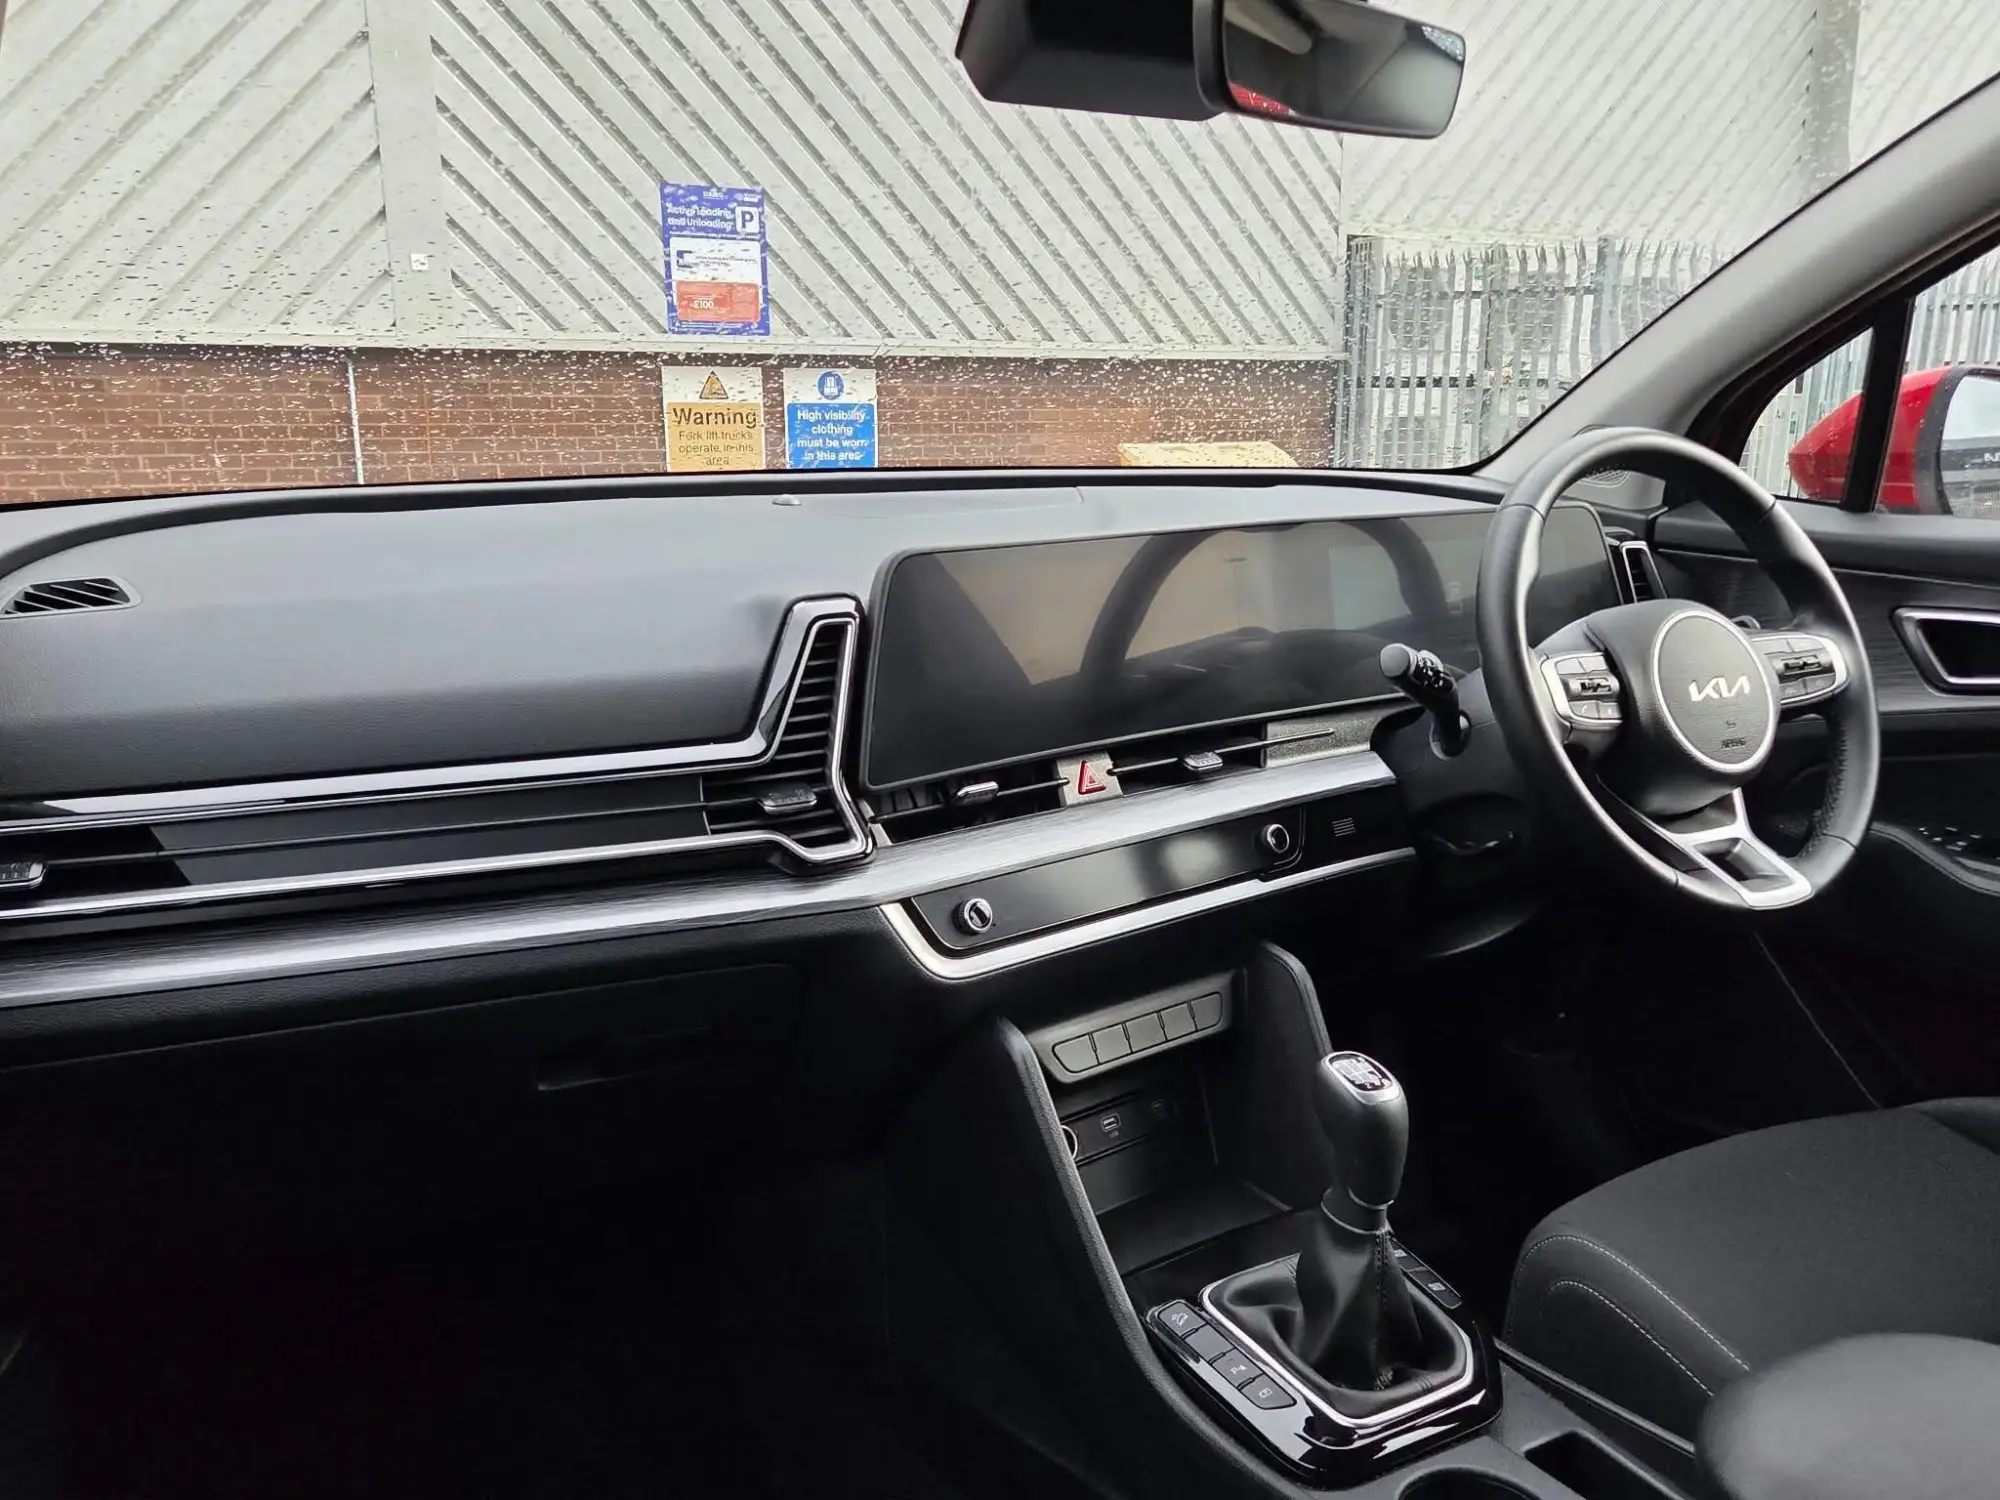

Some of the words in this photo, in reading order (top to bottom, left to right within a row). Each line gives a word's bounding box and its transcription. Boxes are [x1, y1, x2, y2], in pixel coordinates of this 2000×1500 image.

[667, 205, 695, 216] Active
[697, 207, 732, 219] Loading
[668, 217, 686, 226] and
[687, 217, 732, 230] Unloading
[741, 210, 755, 229] P
[693, 300, 714, 309] £100
[672, 407, 757, 429] Warning
[797, 409, 822, 422] High
[824, 409, 866, 422] visibility
[678, 430, 702, 440] Fork
[721, 429, 754, 441] trucks
[811, 423, 854, 436] clothing
[796, 438, 824, 448] must
[825, 438, 840, 447] be
[841, 439, 868, 448] worn
[678, 444, 719, 455] operate
[705, 456, 730, 466] area
[804, 451, 814, 461] in
[816, 451, 837, 461] this
